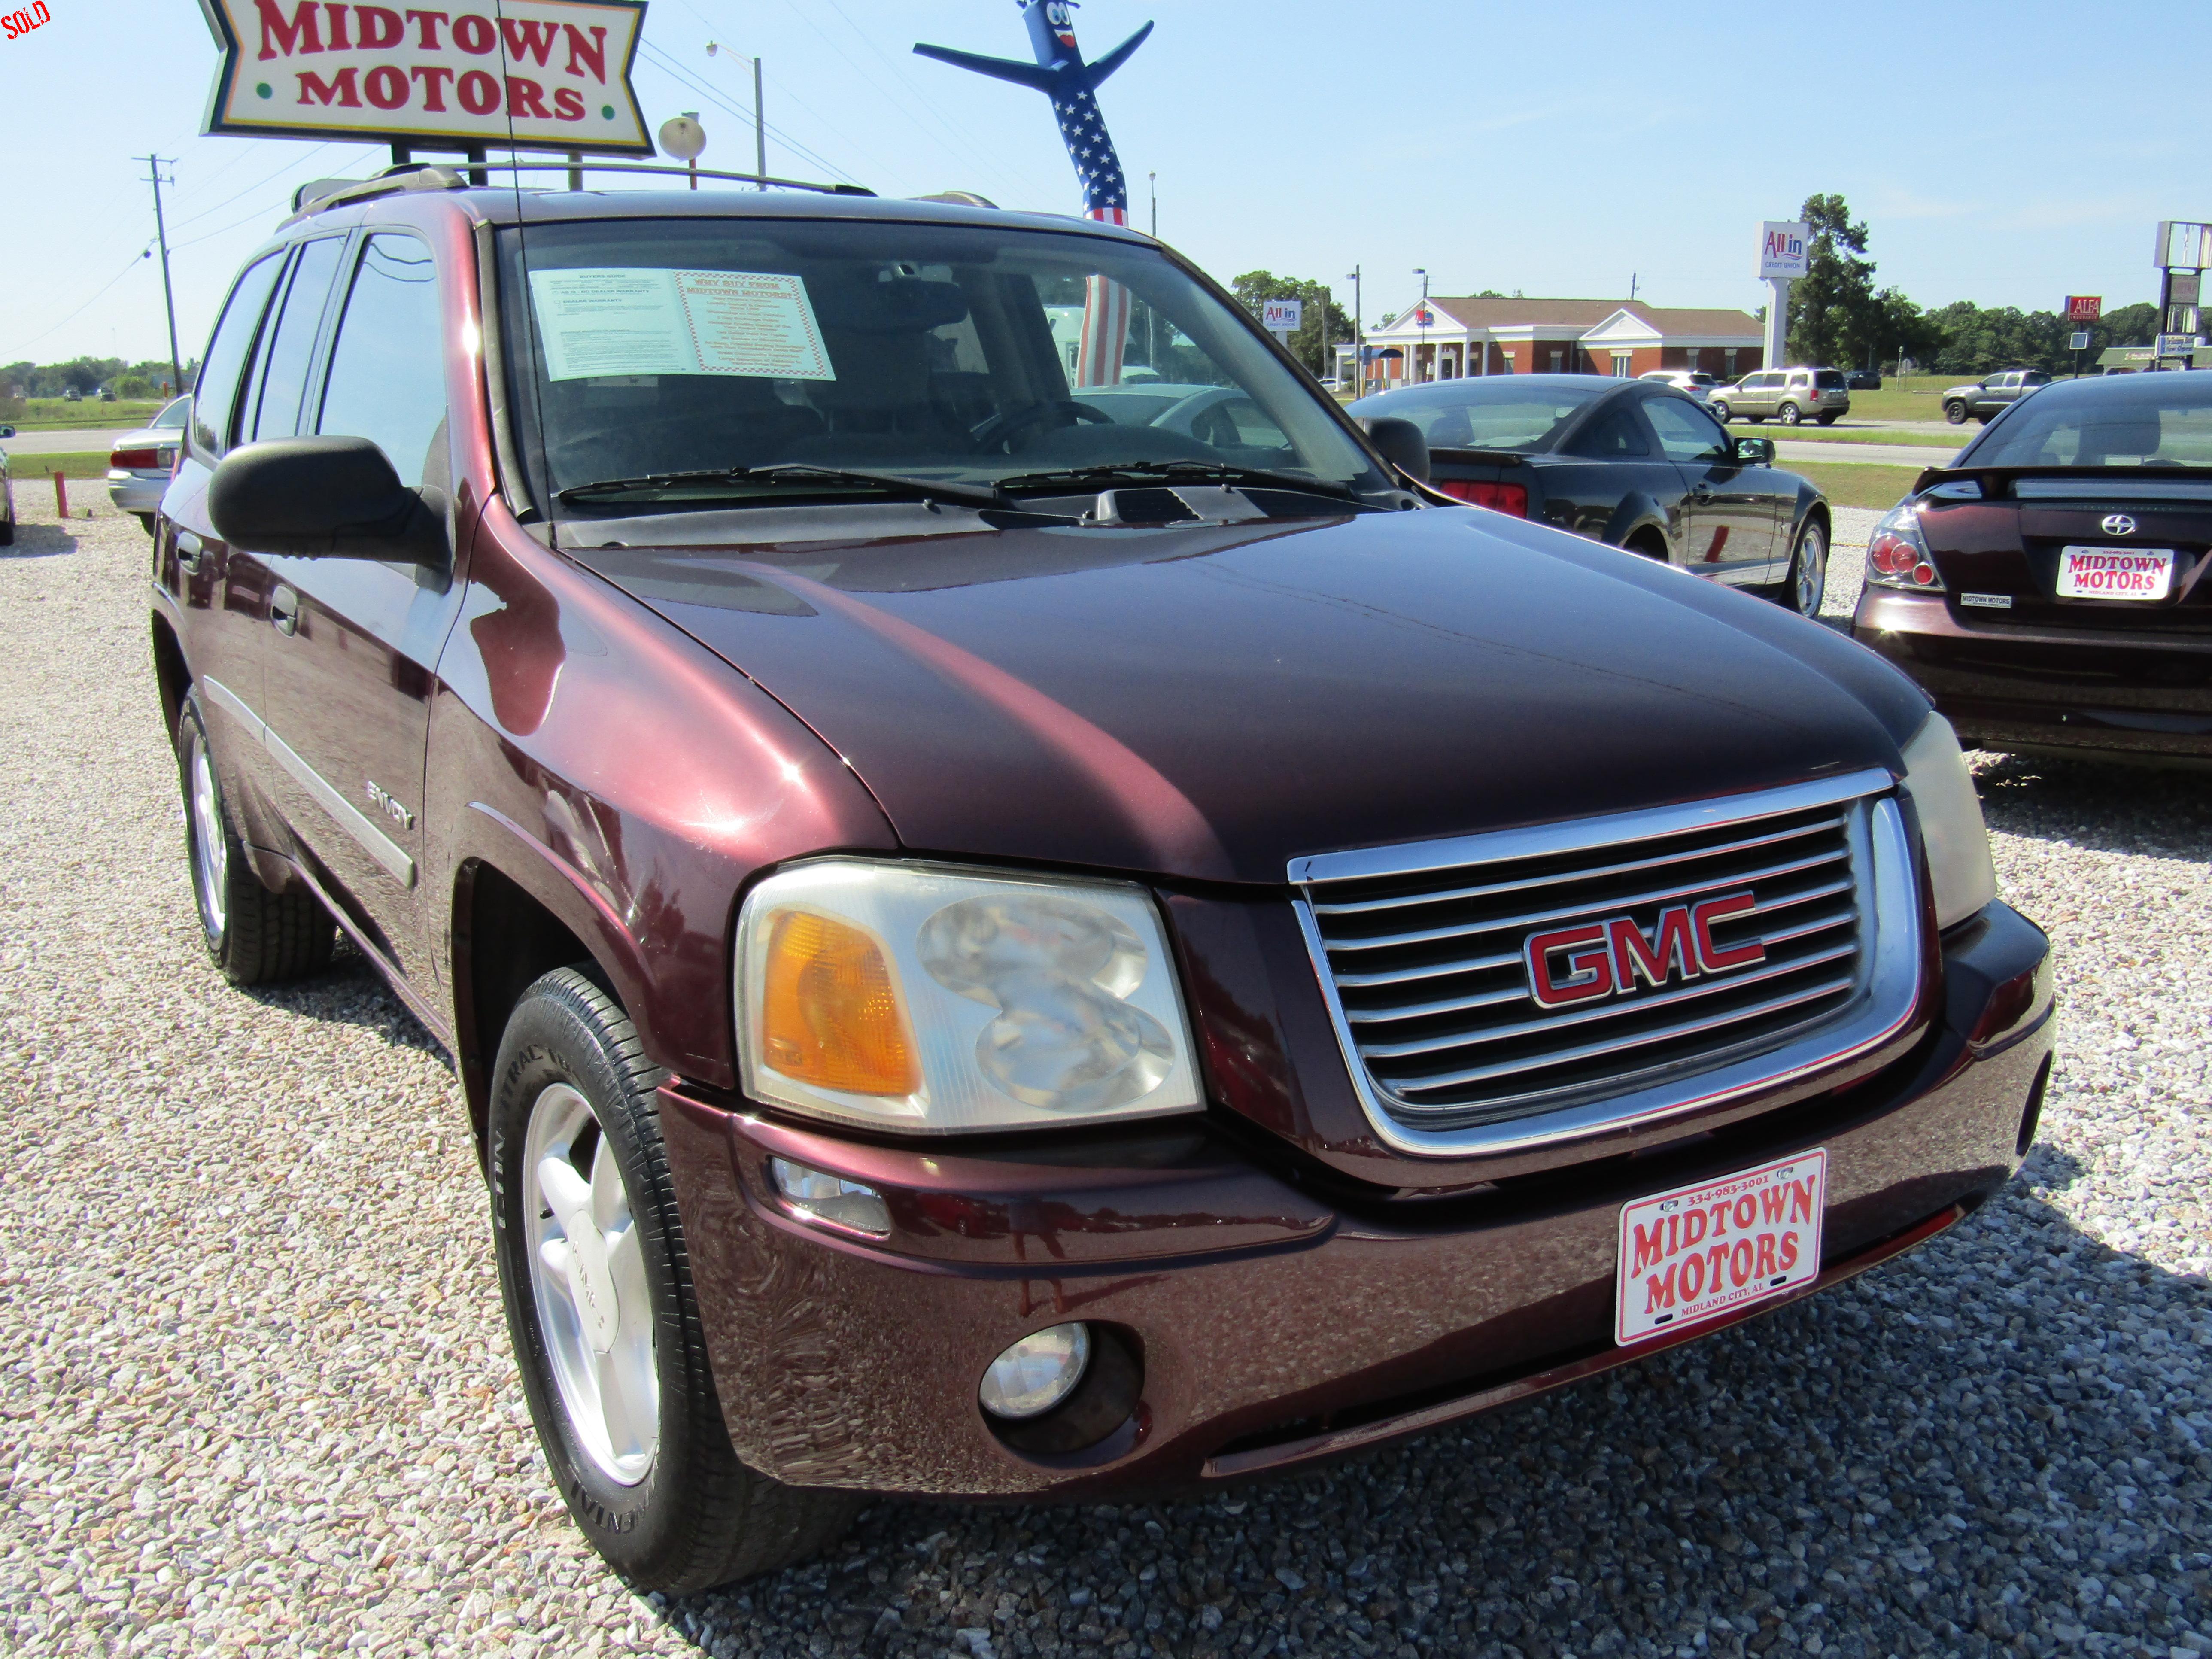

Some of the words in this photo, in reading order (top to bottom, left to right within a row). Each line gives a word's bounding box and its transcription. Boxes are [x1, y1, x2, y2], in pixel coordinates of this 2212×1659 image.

[255, 0, 607, 85] MIDTOWN
[295, 65, 586, 121] MOTORS
[1765, 231, 1786, 258] All
[1788, 234, 1802, 255] in
[1265, 307, 1282, 321] All
[1285, 307, 1295, 319] in
[2074, 300, 2099, 313] ALFA
[2068, 554, 2167, 576] MIDTOWN
[2073, 571, 2156, 590] MOTORS
[1524, 890, 1766, 1010] GMC
[1687, 1174, 1769, 1207] 334-983-3001
[1630, 1174, 1816, 1279] MIDTOWN
[1644, 1230, 1799, 1315] MOTORS
[1681, 1295, 1726, 1317] MIDLAND
[1728, 1287, 1750, 1301] CITY,
[1752, 1282, 1764, 1293] AL
